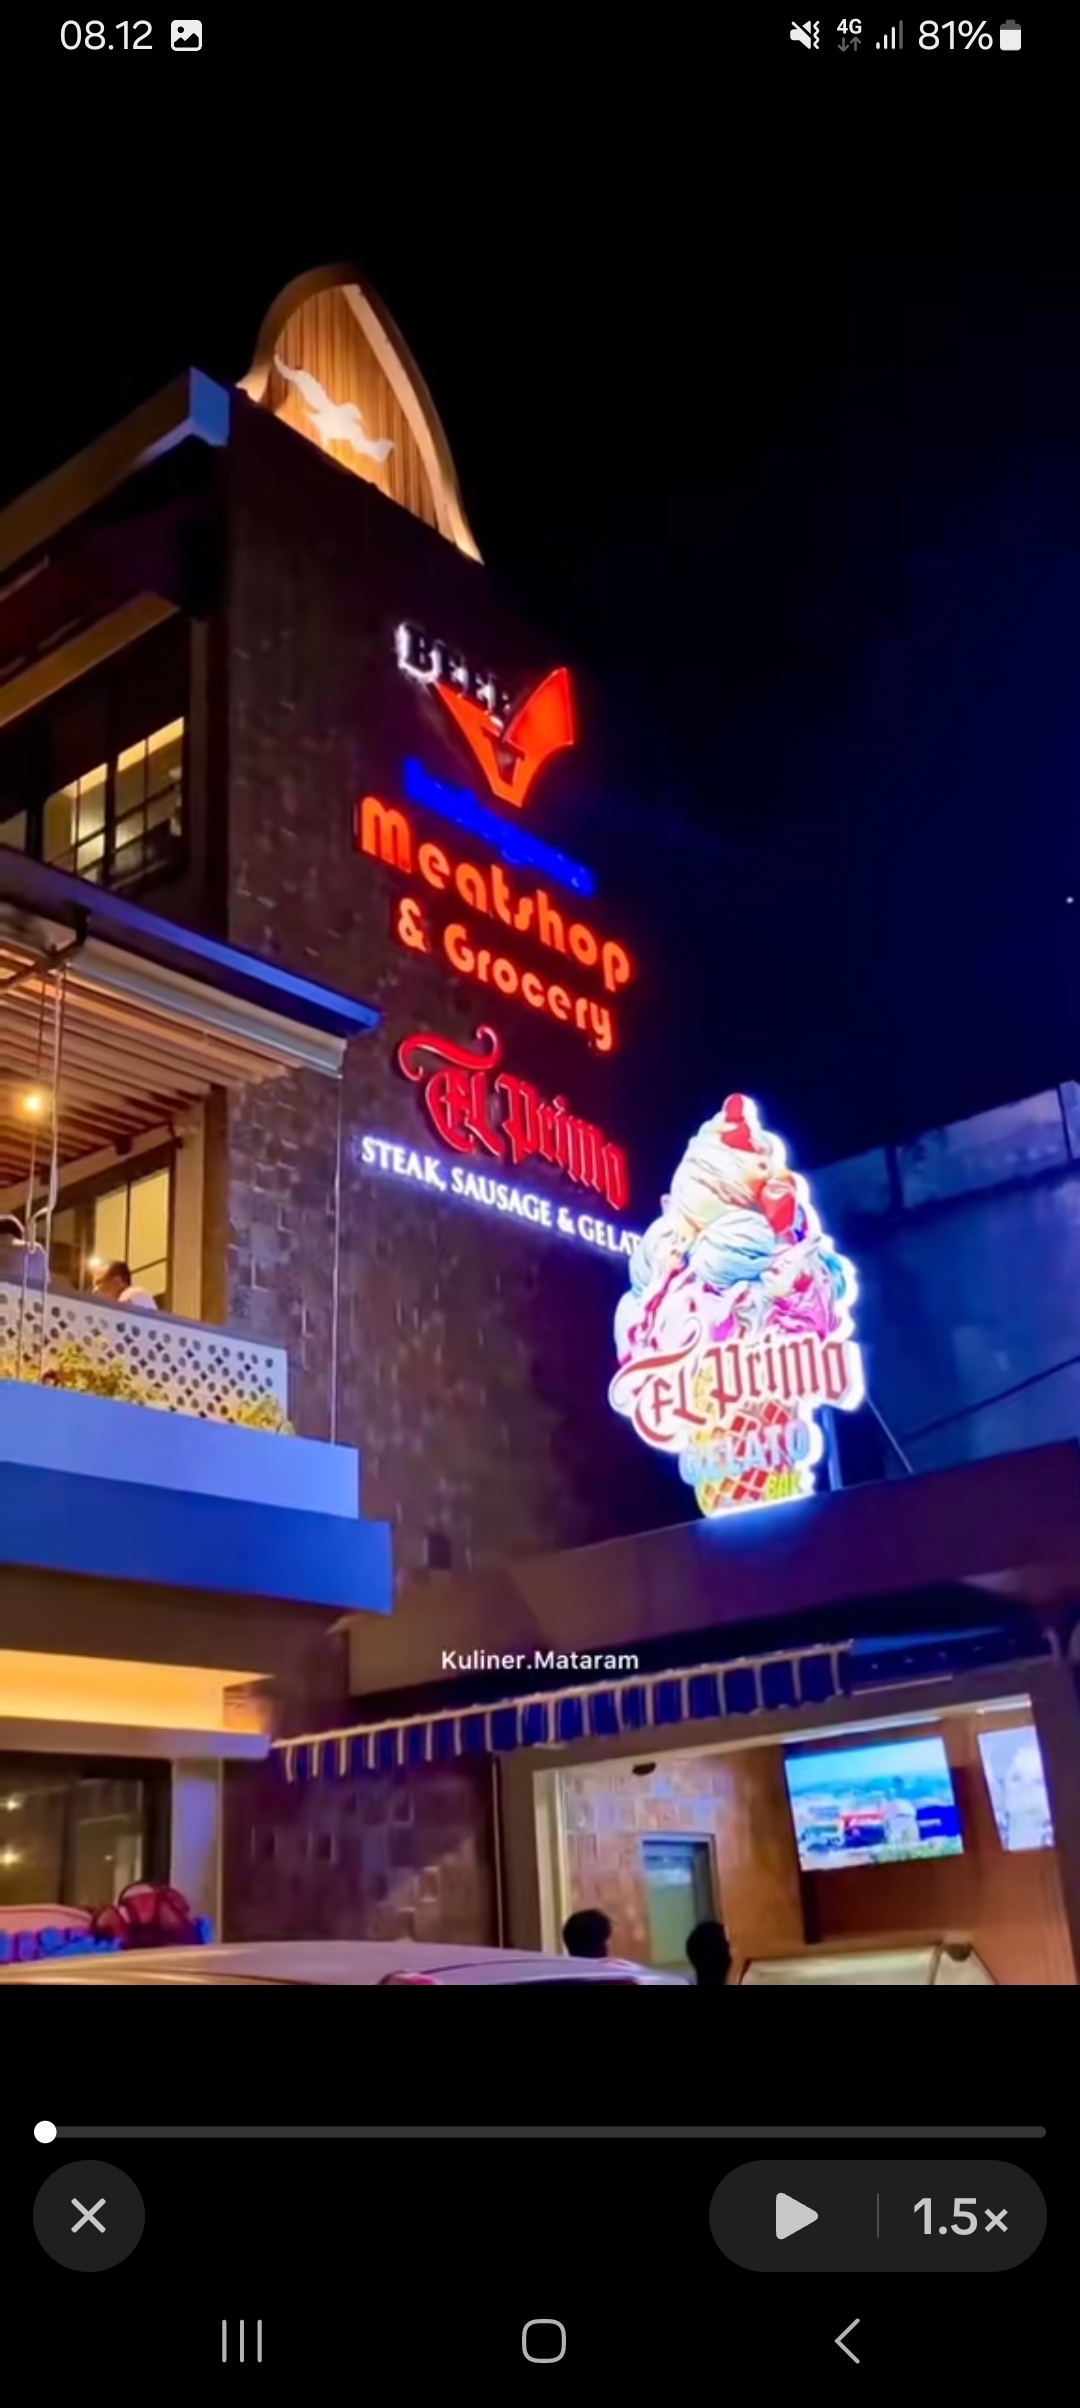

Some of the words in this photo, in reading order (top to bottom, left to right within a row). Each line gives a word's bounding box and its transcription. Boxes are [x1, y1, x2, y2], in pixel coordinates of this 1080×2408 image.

[361, 797, 631, 992] Meatshop
[398, 898, 427, 953] &
[444, 924, 613, 1051] Grocery
[361, 1135, 448, 1192] STEAK,
[450, 1166, 553, 1228] SAUSAGE
[557, 1207, 576, 1235] &
[577, 1214, 643, 1256] GELAT
[495, 1073, 628, 1211] Primo
[702, 1333, 849, 1419] Primo
